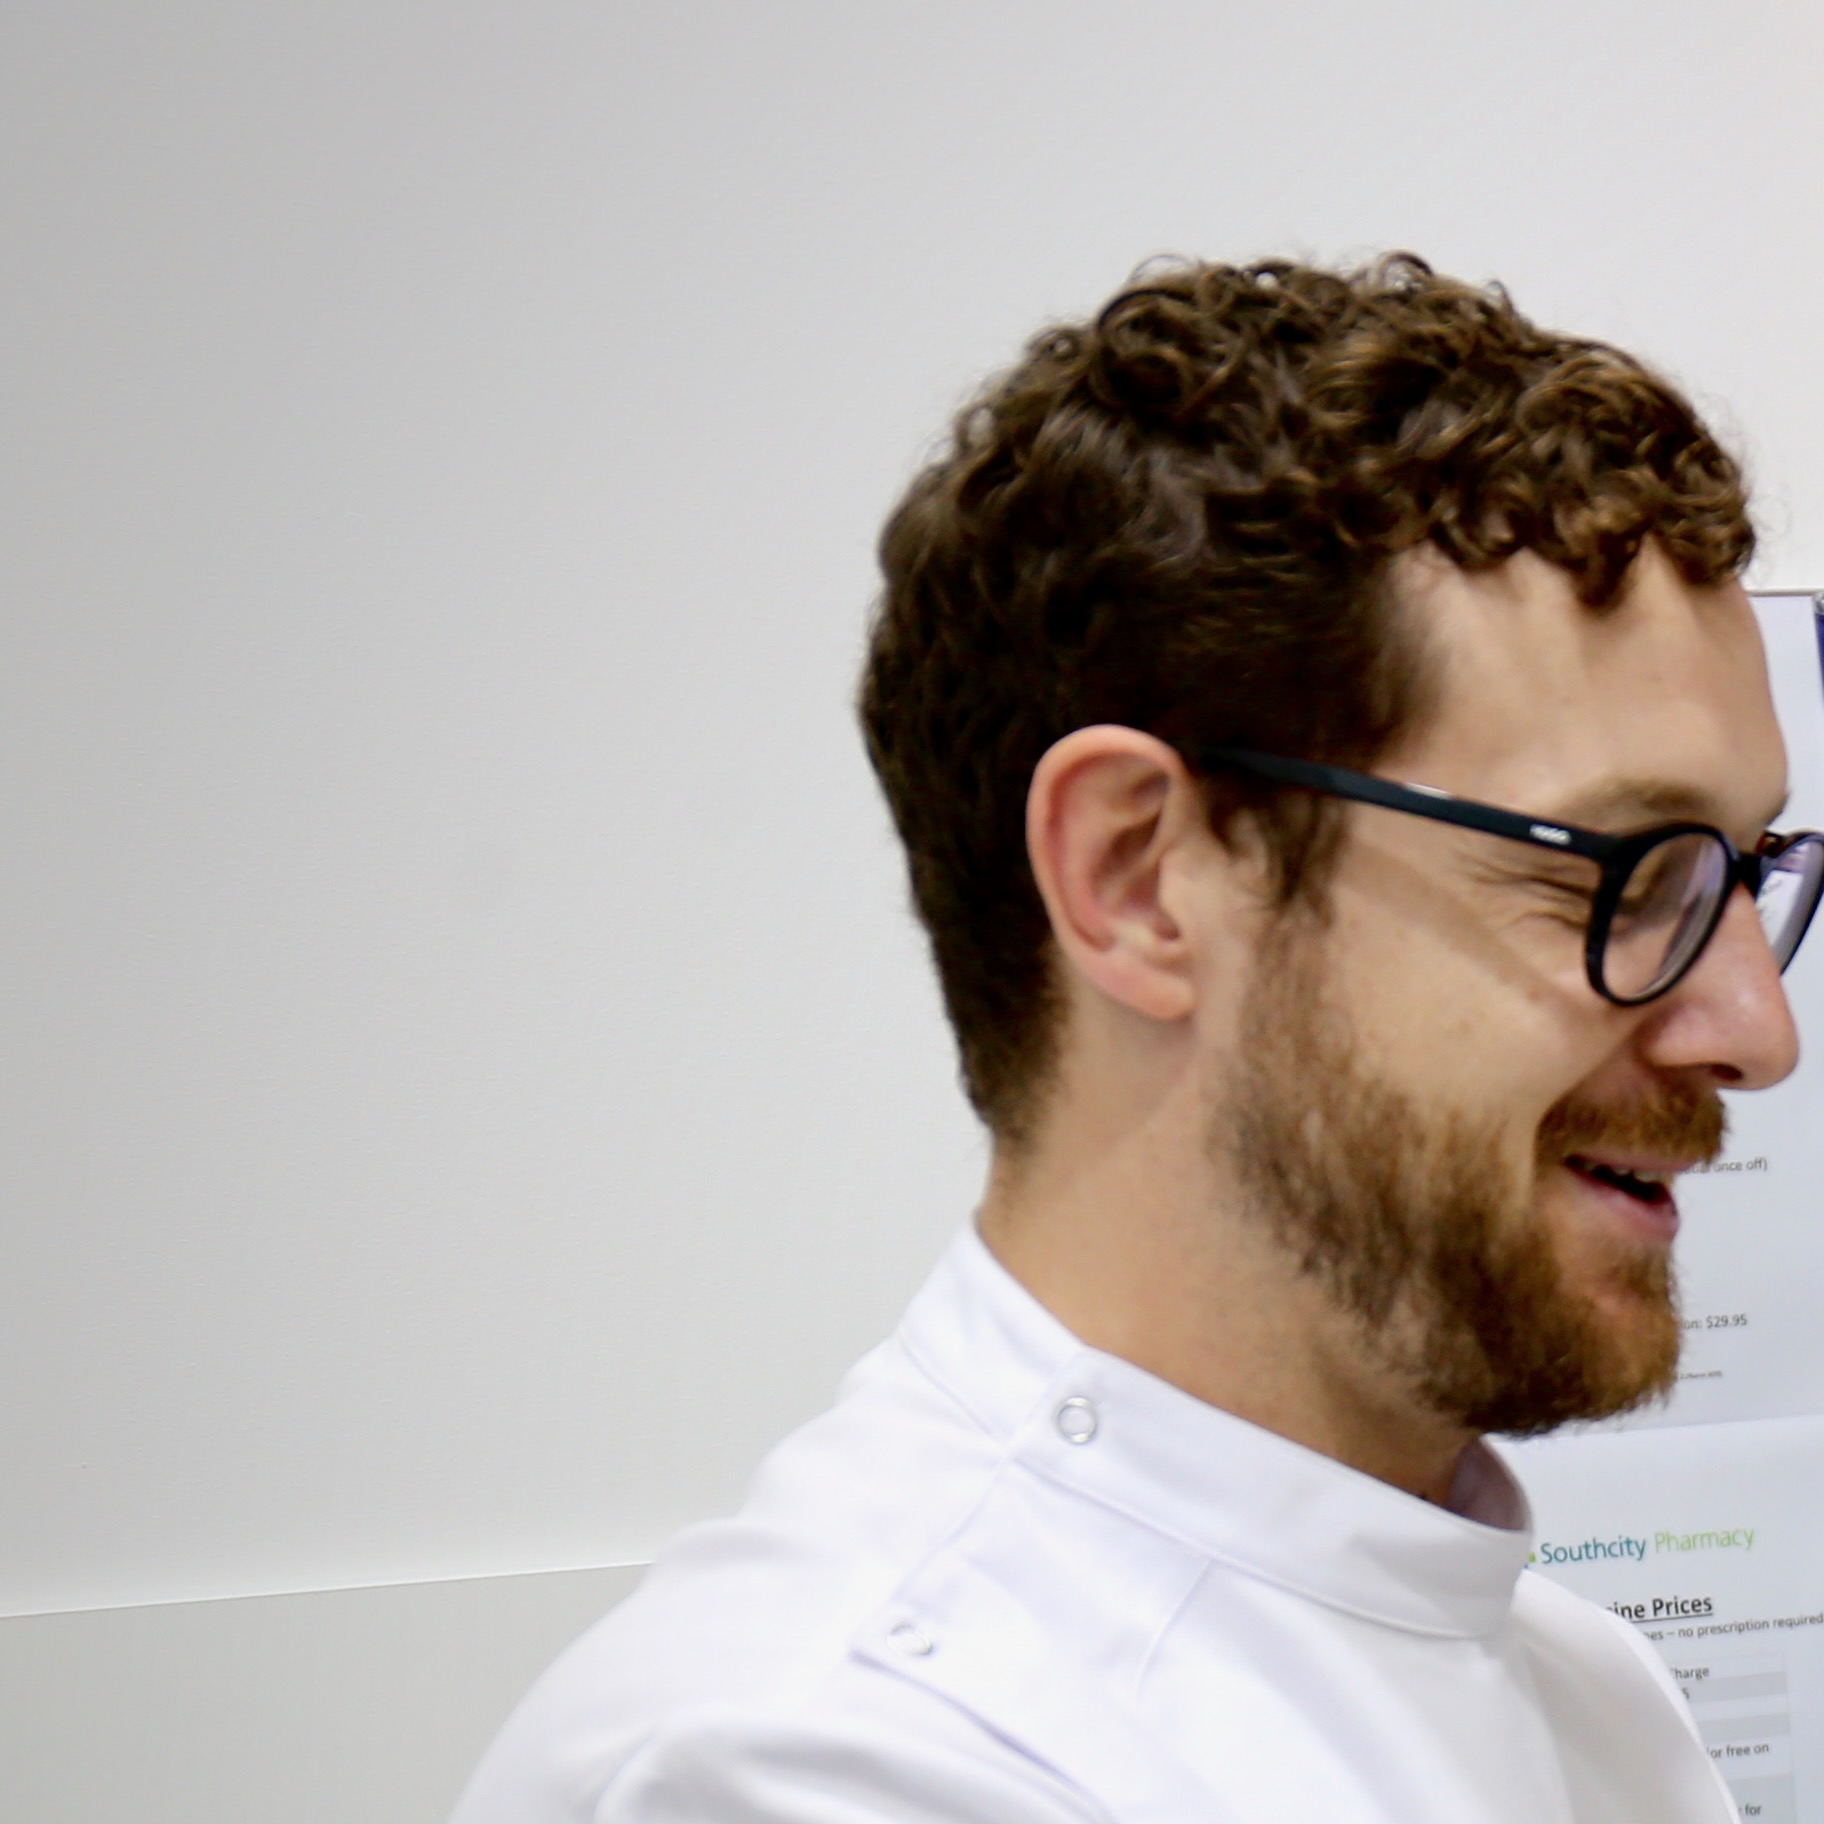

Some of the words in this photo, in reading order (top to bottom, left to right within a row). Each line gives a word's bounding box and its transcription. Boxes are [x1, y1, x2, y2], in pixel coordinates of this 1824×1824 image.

[1746, 1157, 1768, 1172] off)
[1706, 1314, 1748, 1330] $29.95
[1540, 1534, 1646, 1564] Southcity
[1654, 1528, 1755, 1553] Pharmacy
[1651, 1596, 1713, 1618] Prices
[1678, 1626, 1694, 1638] no
[1696, 1618, 1770, 1638] prescription
[1772, 1612, 1824, 1629] required
[1726, 1744, 1750, 1757] free
[1754, 1743, 1769, 1754] on
[1745, 1804, 1762, 1816] for
